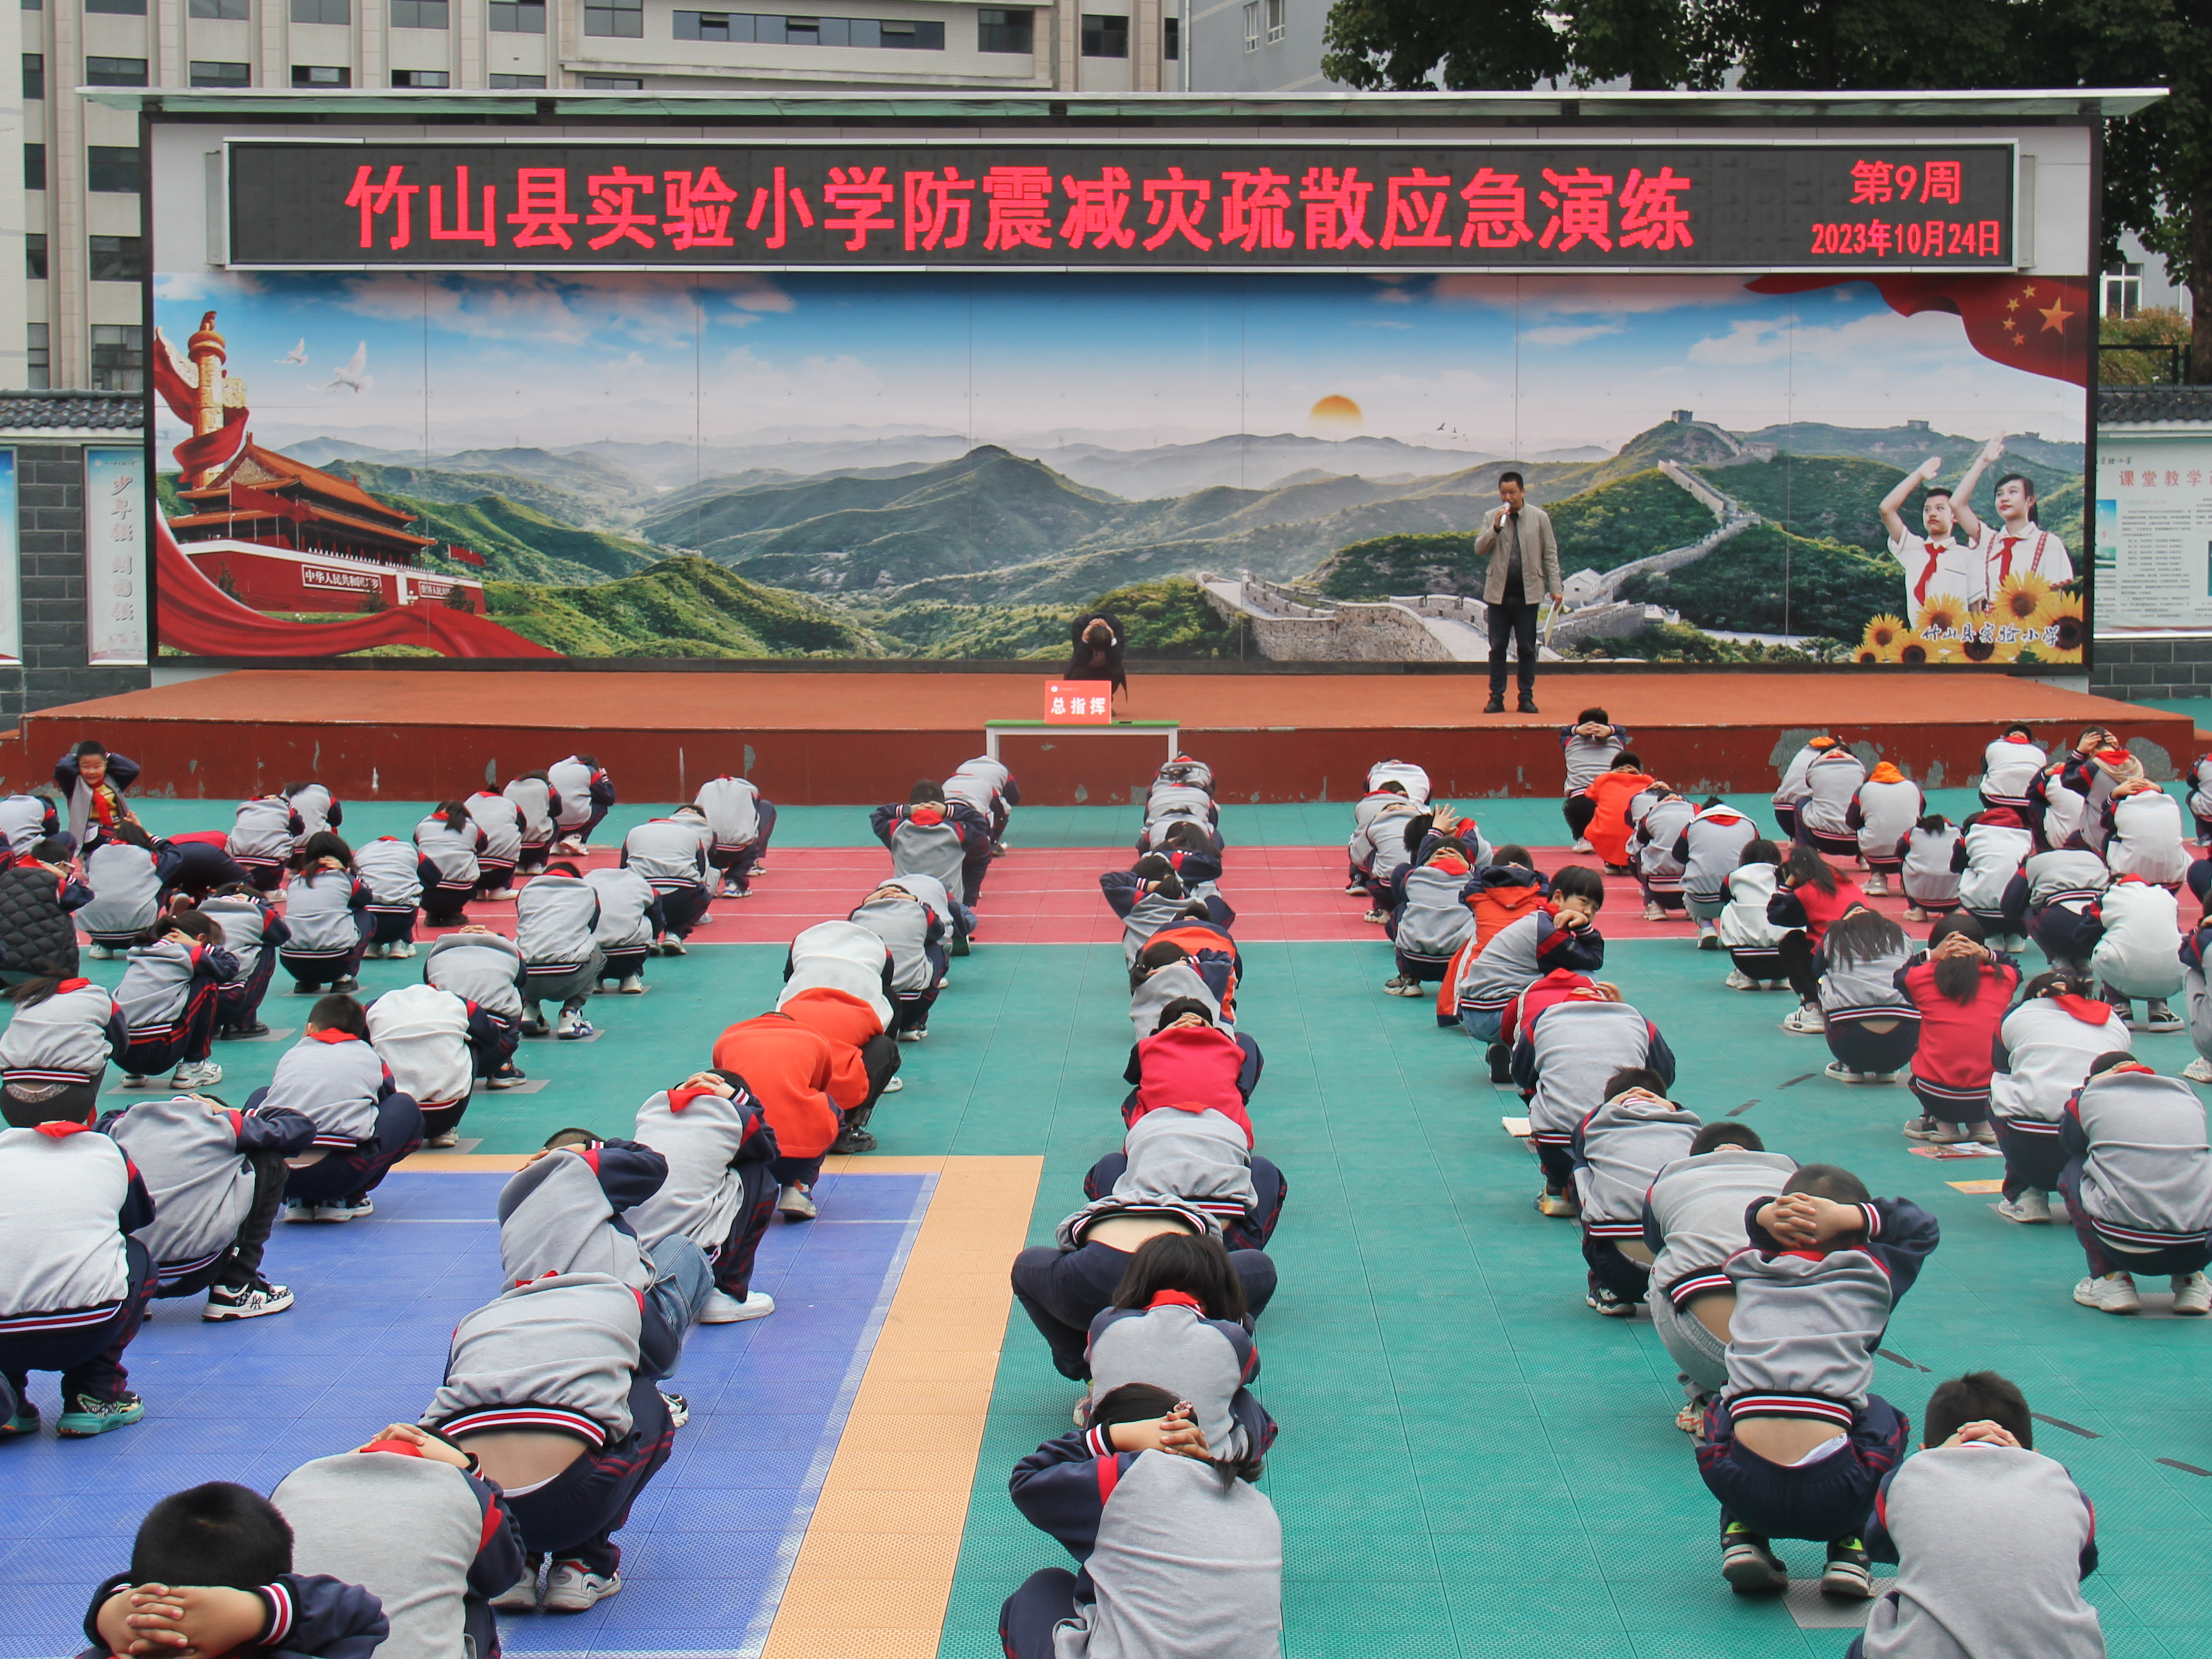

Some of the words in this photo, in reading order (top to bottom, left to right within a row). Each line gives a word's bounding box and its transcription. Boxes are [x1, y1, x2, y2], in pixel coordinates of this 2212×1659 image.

[1850, 160, 1961, 205] 第9周
[345, 165, 1694, 252] 竹山县实验小学防震减灾疏散应急演练
[1811, 218, 2000, 257] 2023年10月24日
[2120, 470, 2212, 487] 课堂教学
[1920, 622, 2060, 647] 竹山县实验小学
[1050, 697, 1106, 715] 总指挥
